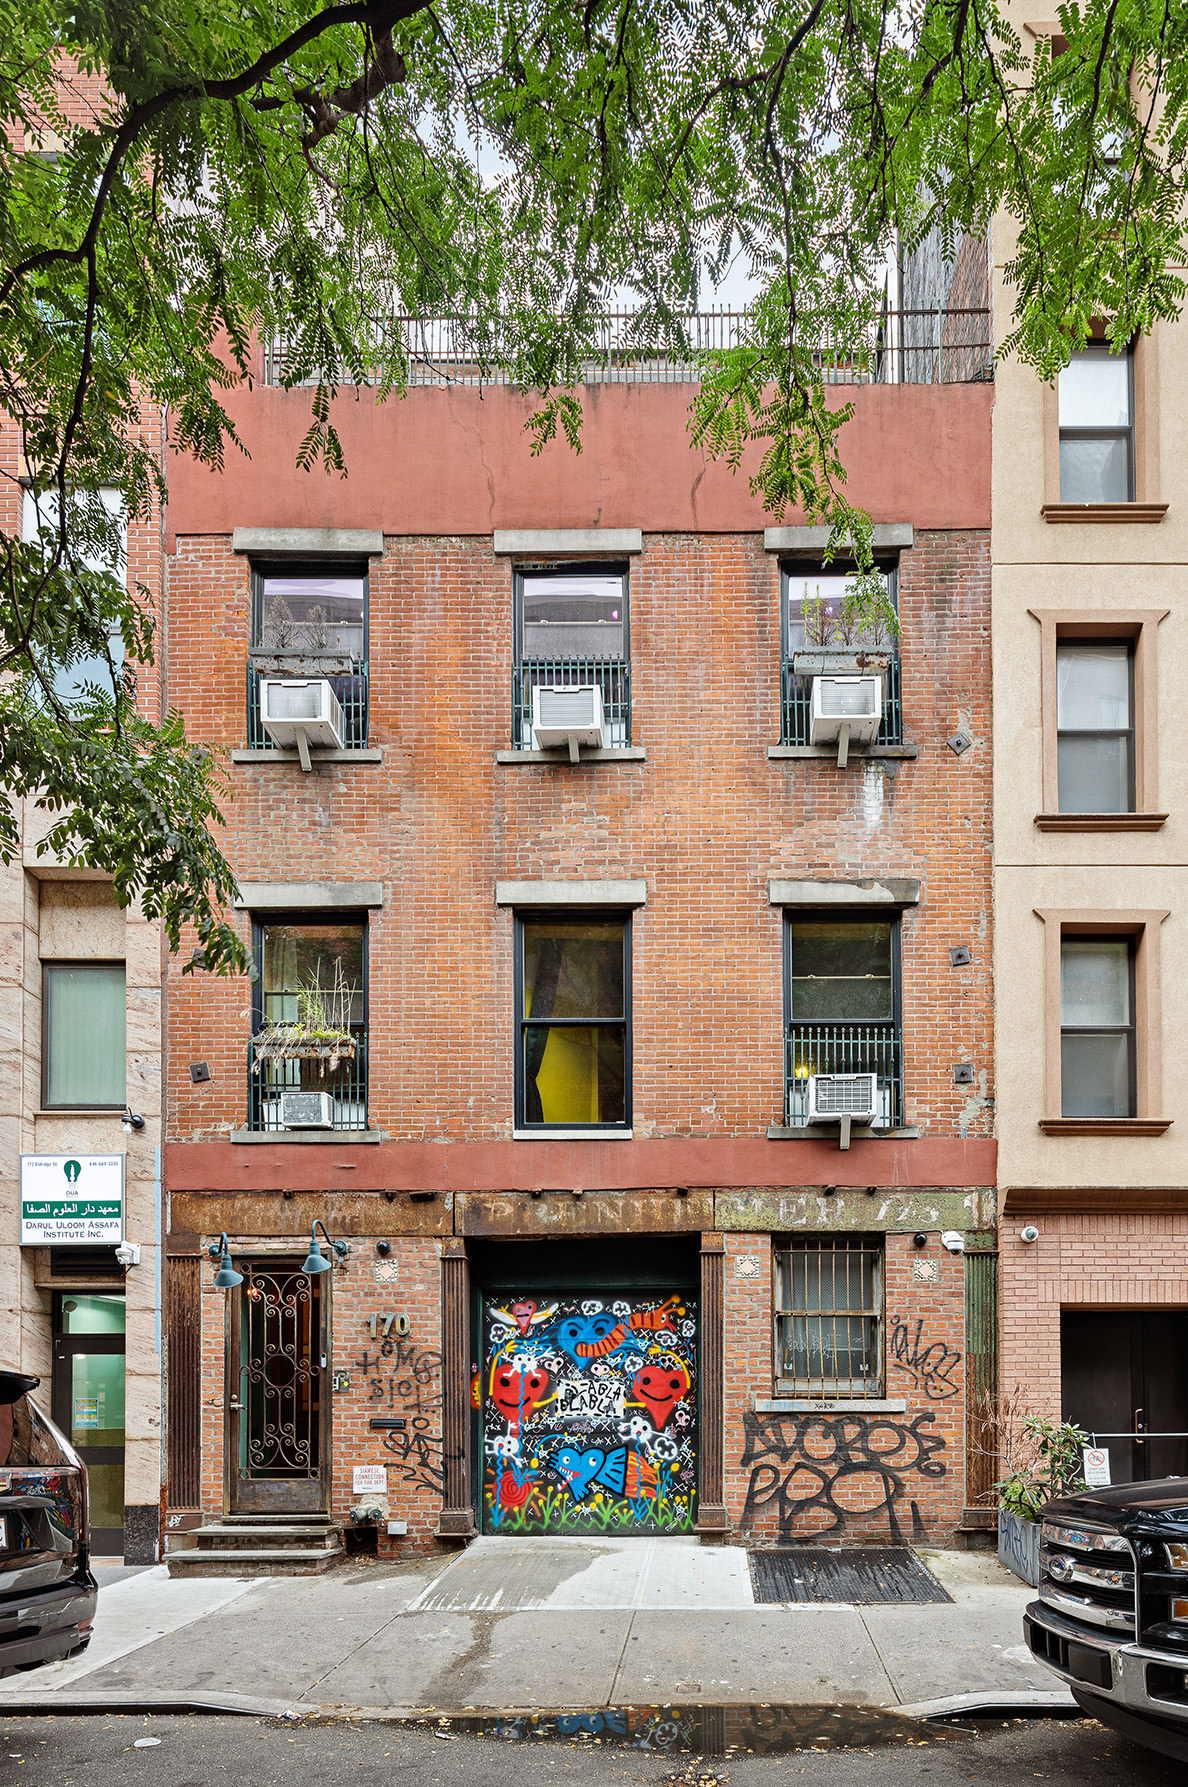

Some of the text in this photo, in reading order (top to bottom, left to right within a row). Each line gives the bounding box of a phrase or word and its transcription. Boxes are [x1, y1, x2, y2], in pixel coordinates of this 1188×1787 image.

[26, 1202, 119, 1217] معهد دار العلوم الصفا
[56, 1221, 85, 1229] ULOOM
[88, 1221, 119, 1229] ASSAFA
[43, 1230, 104, 1238] INSTITUTE INC.
[366, 1312, 411, 1340] 170
